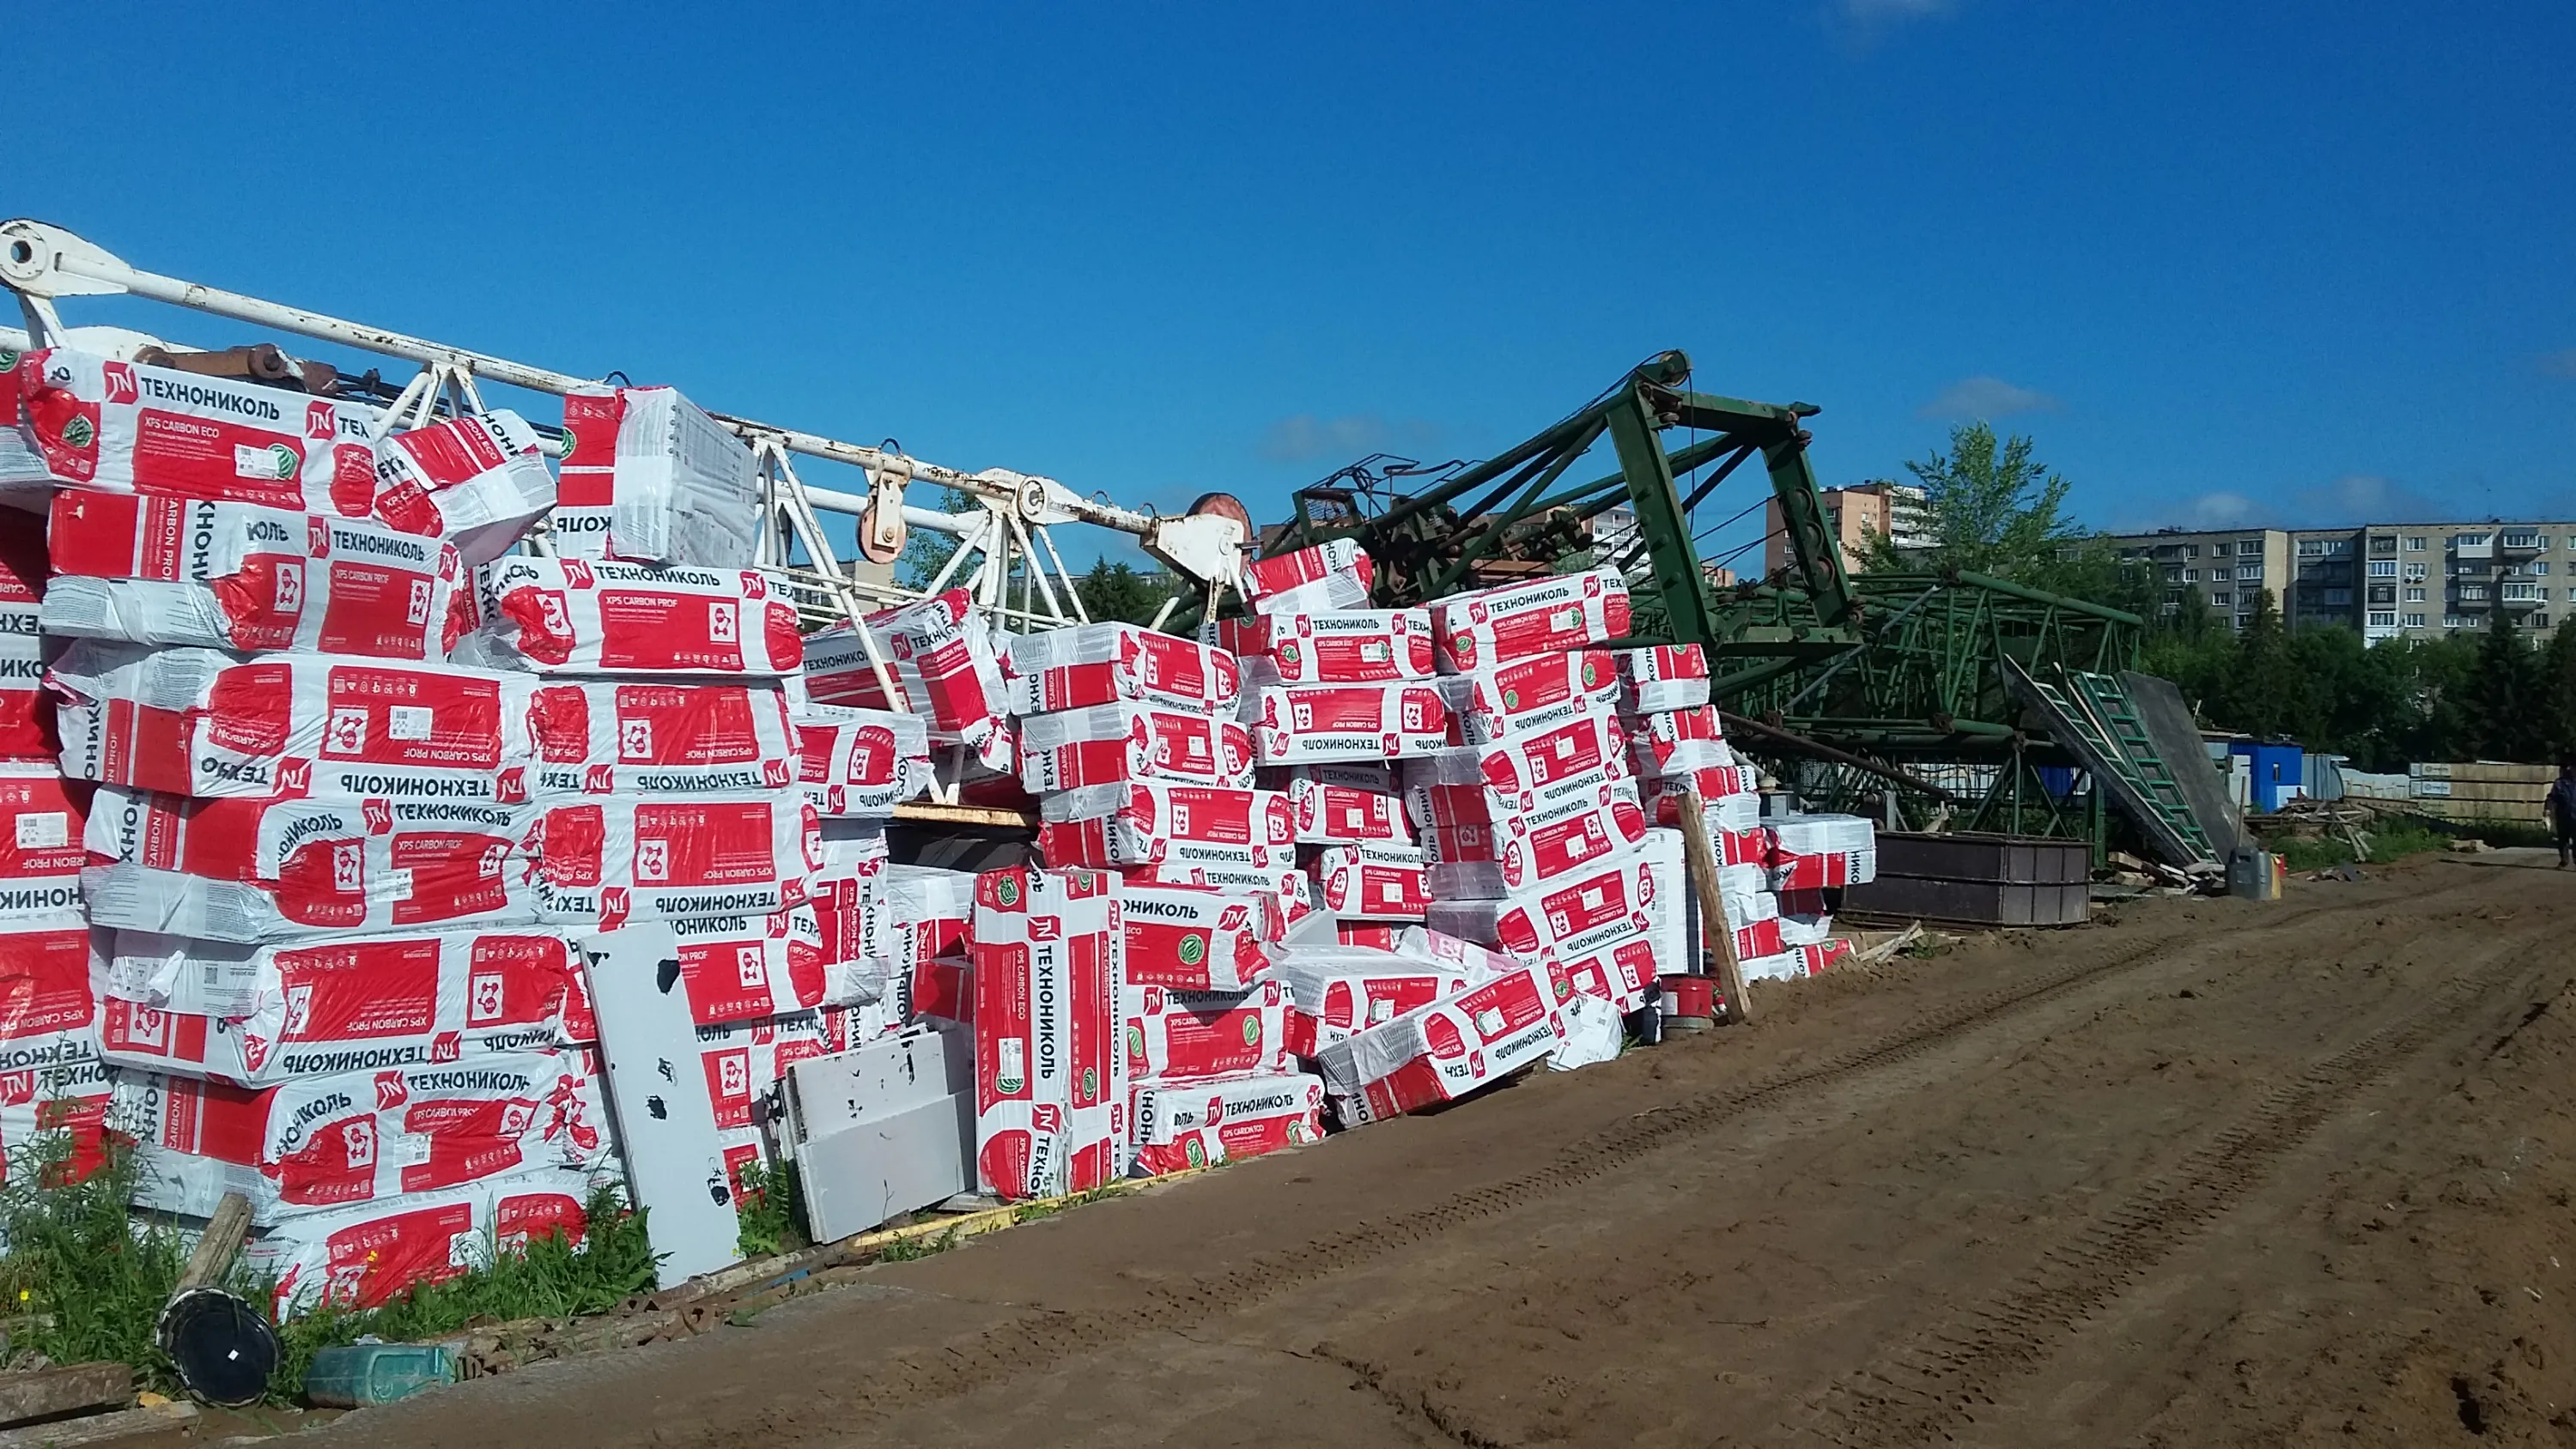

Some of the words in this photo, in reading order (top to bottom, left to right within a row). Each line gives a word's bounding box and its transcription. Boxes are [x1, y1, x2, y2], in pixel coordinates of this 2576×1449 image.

[141, 378, 280, 421] ТЕХНОНИКОЛЬ
[144, 417, 161, 429] XPS
[162, 419, 200, 436] CARBON
[201, 427, 220, 439] ECO
[557, 516, 611, 533] КОЛЬ
[333, 530, 425, 561] ТЕХНОНИКОЛЬ
[594, 565, 720, 586] ТЕХНОНИКОЛЬ
[605, 596, 622, 605] XPS
[623, 597, 656, 606] CARBON
[658, 598, 677, 608] PROF
[1490, 587, 1570, 614] ТЕХНОНИКОЛЬ
[1313, 619, 1379, 630] ТЕХНОНИКОЛЬ
[1515, 706, 1573, 729] ТЕХНОНИКОЛЬ
[404, 750, 428, 759] PROF
[1303, 739, 1380, 750] ТЕХНОНИКОЛЬ
[429, 751, 471, 761] CARBON
[341, 774, 490, 796] ТЕХНОНИКОЛЬ
[637, 773, 762, 790] ТЕХНОНИКОЛЬ
[1323, 769, 1380, 784] ТЕХНОНИКОЛЬ
[1545, 772, 1606, 801] ТЕХНОНИКОЛЬ
[395, 803, 511, 827] ТЕХНОНИКОЛЬ
[1526, 799, 1589, 826] ТЕХНОНИКОЛЬ
[149, 817, 161, 867] CARBON
[398, 840, 414, 851] XPS
[415, 840, 444, 851] CARBON
[22, 859, 52, 869] PROF
[1179, 846, 1250, 862] ТЕХНОНИКОЛЬ
[1206, 872, 1270, 887] ТЕХНОНИКОЛЬ
[656, 891, 776, 913] ТЕХНОНИКОЛЬ
[1567, 921, 1633, 951] ТЕХНОНИКОЛЬ
[689, 950, 708, 960] PROF
[1166, 991, 1249, 1005] ТЕХНОНИКОЛЬ
[65, 1009, 84, 1022] XPS
[1038, 945, 1055, 1079] ТЕХНОНИКОЛЬ
[1111, 939, 1120, 1078] ТЕХНОНИКОЛЬ
[346, 1021, 370, 1031] PROF
[372, 1018, 408, 1029] CARBON
[410, 1016, 427, 1028] XPS
[1495, 1025, 1554, 1060] ТЕХНОНИКОЛЬ
[283, 1046, 425, 1074] ТЕХНОНИКОЛЬ
[408, 1071, 532, 1091] ТЕХНОНИКОЛЬ
[1225, 1094, 1294, 1116] ТЕХНОНИКОЛЬ
